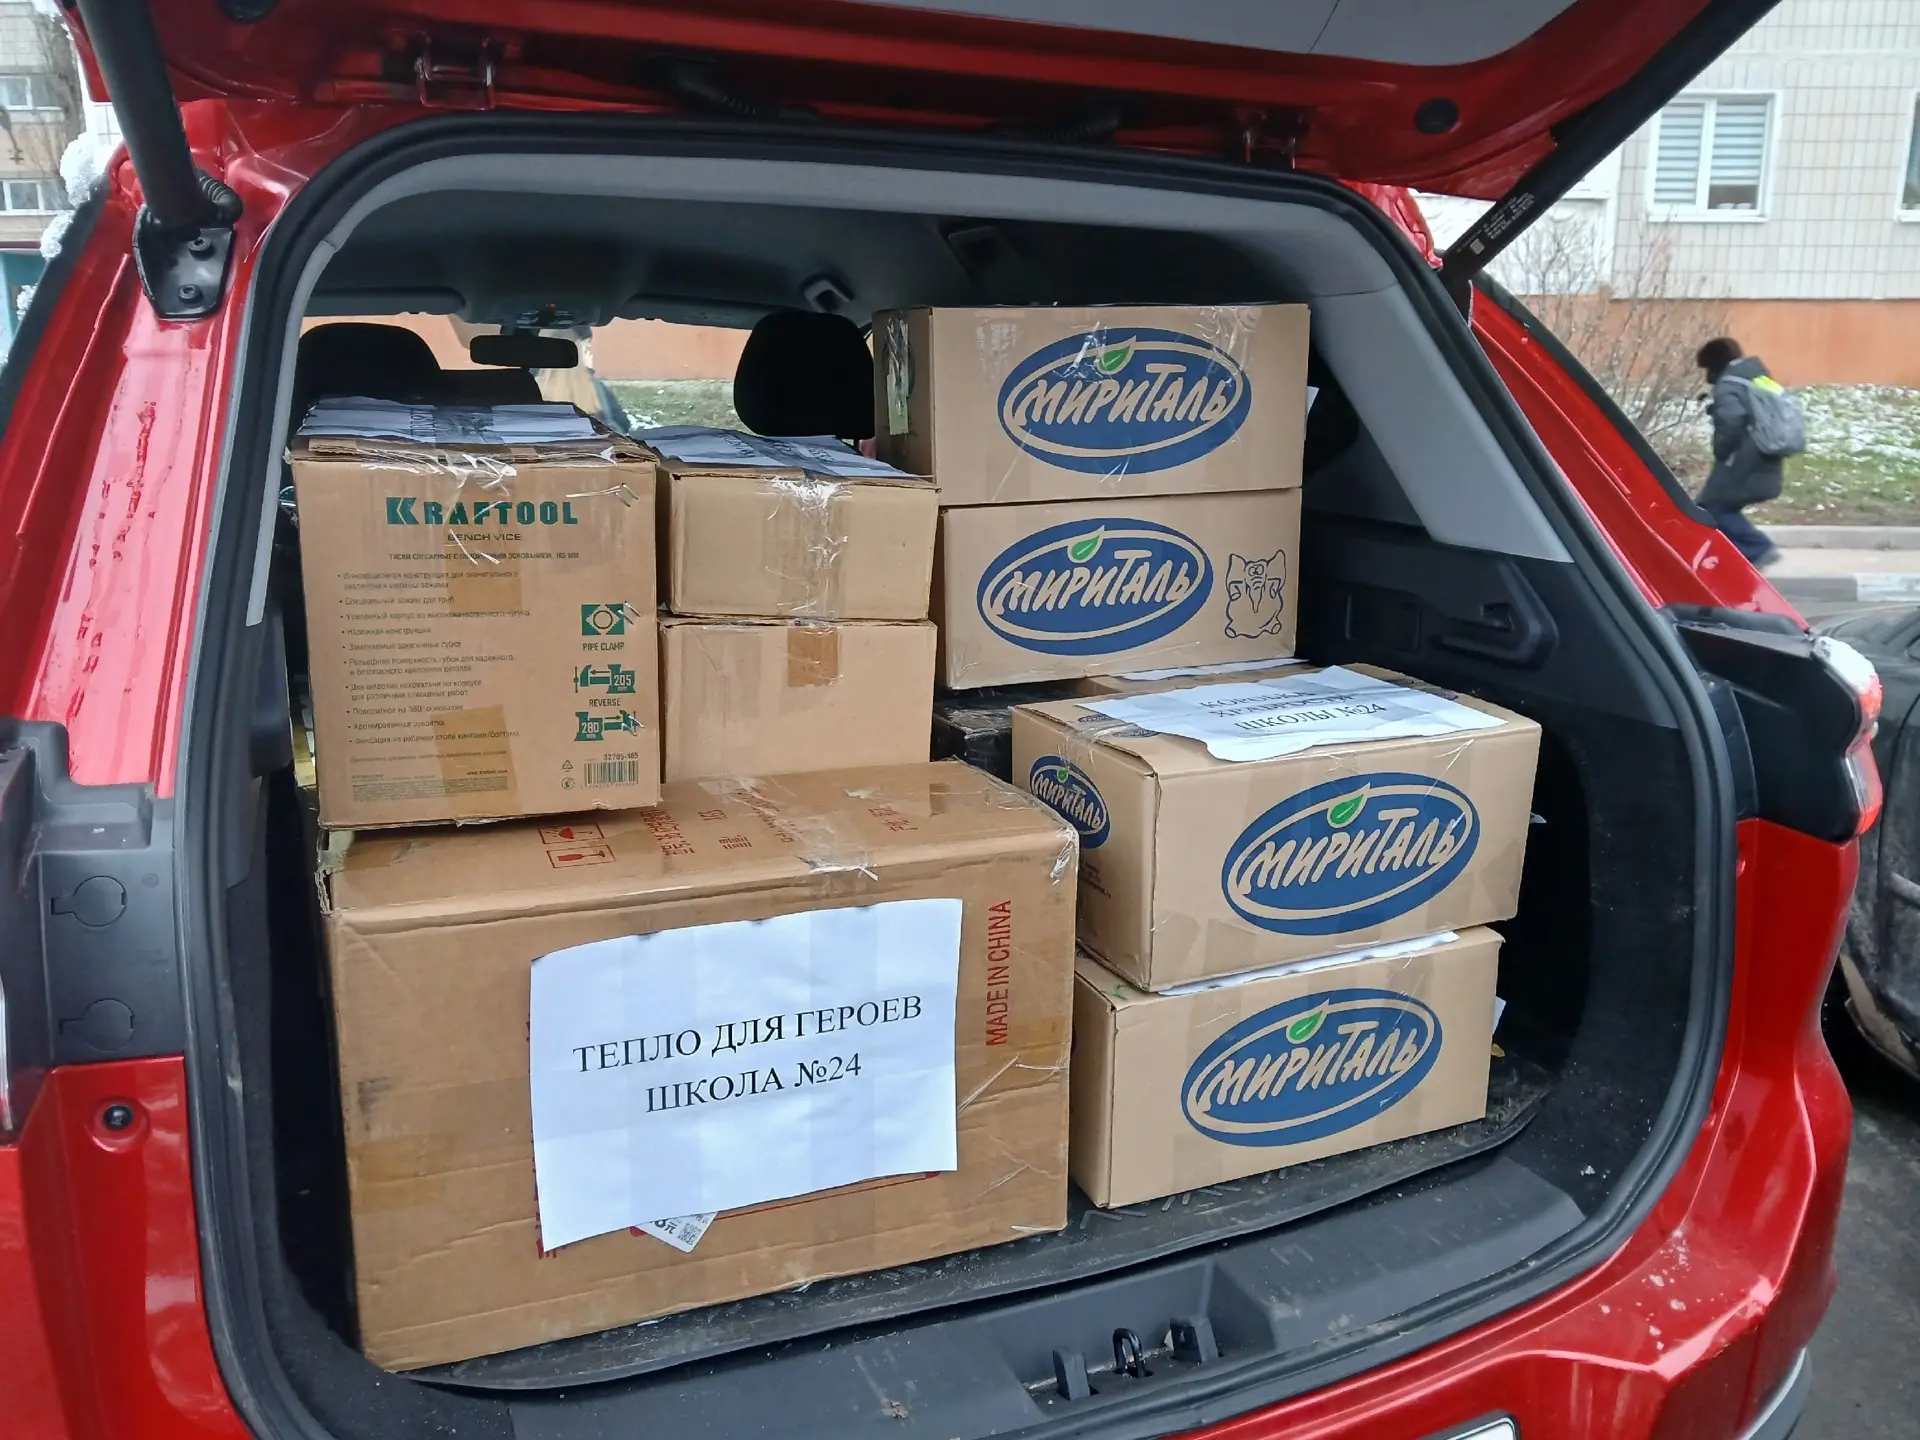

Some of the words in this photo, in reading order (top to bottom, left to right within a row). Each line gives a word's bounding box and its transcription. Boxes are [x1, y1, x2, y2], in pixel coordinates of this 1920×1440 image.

[386, 497, 578, 525] KRAFTOOL
[493, 533, 522, 541] VICE
[582, 642, 599, 651] PIPE
[601, 641, 624, 651] CLAMP
[614, 674, 632, 687] 205
[589, 698, 620, 707] REVERSE
[582, 722, 599, 734] 280
[1233, 709, 1336, 731] ШКОЛЫ
[1335, 702, 1387, 717] №24
[987, 899, 1012, 962] CHINA
[987, 965, 1010, 987] IN
[985, 988, 1009, 1046] MADE
[572, 1028, 702, 1073] ТЕПЛО
[711, 1014, 784, 1058] ДЛЯ
[794, 994, 923, 1039] ГЕРОЕВ
[645, 1063, 785, 1113] ШКОЛА
[794, 1052, 862, 1089] №24
